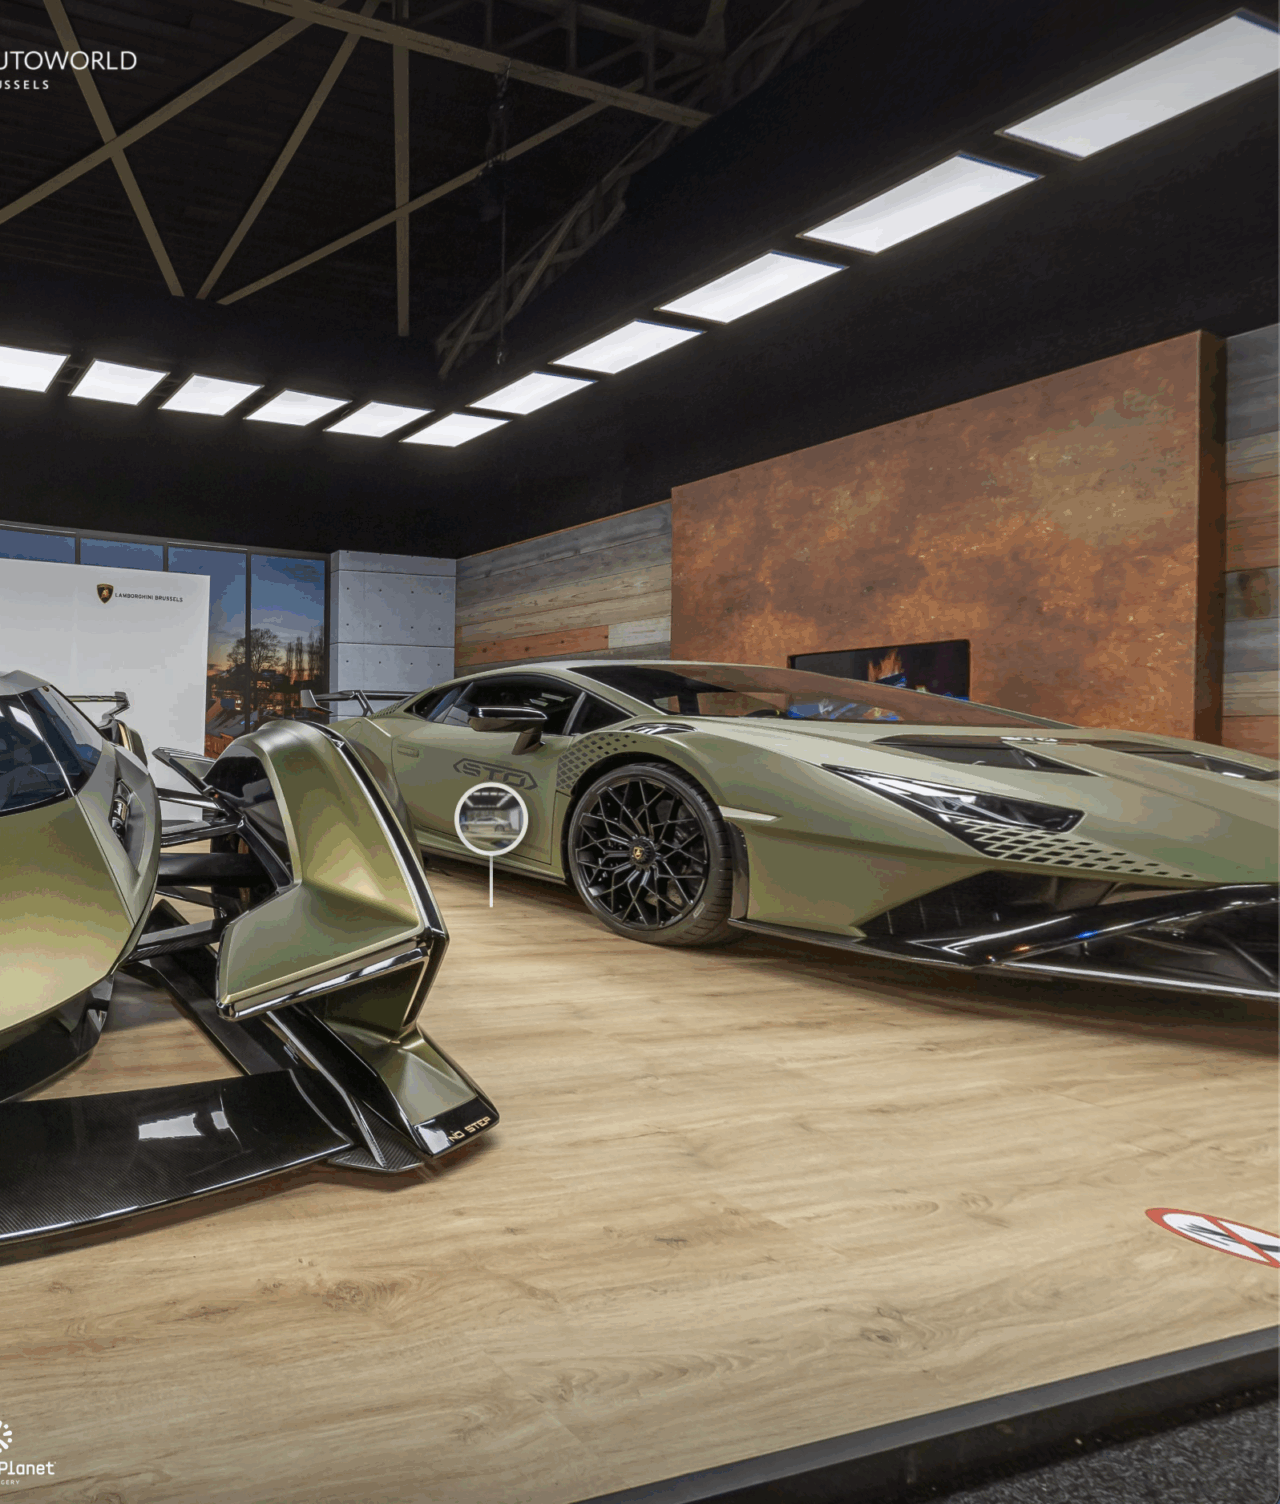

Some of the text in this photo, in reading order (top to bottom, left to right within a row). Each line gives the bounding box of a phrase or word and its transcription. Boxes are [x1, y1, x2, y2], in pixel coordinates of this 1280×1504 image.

[114, 592, 184, 603] LAMBORGHINI BRUSSELS
[462, 762, 526, 789] STO
[448, 1115, 491, 1143] NO STEP
